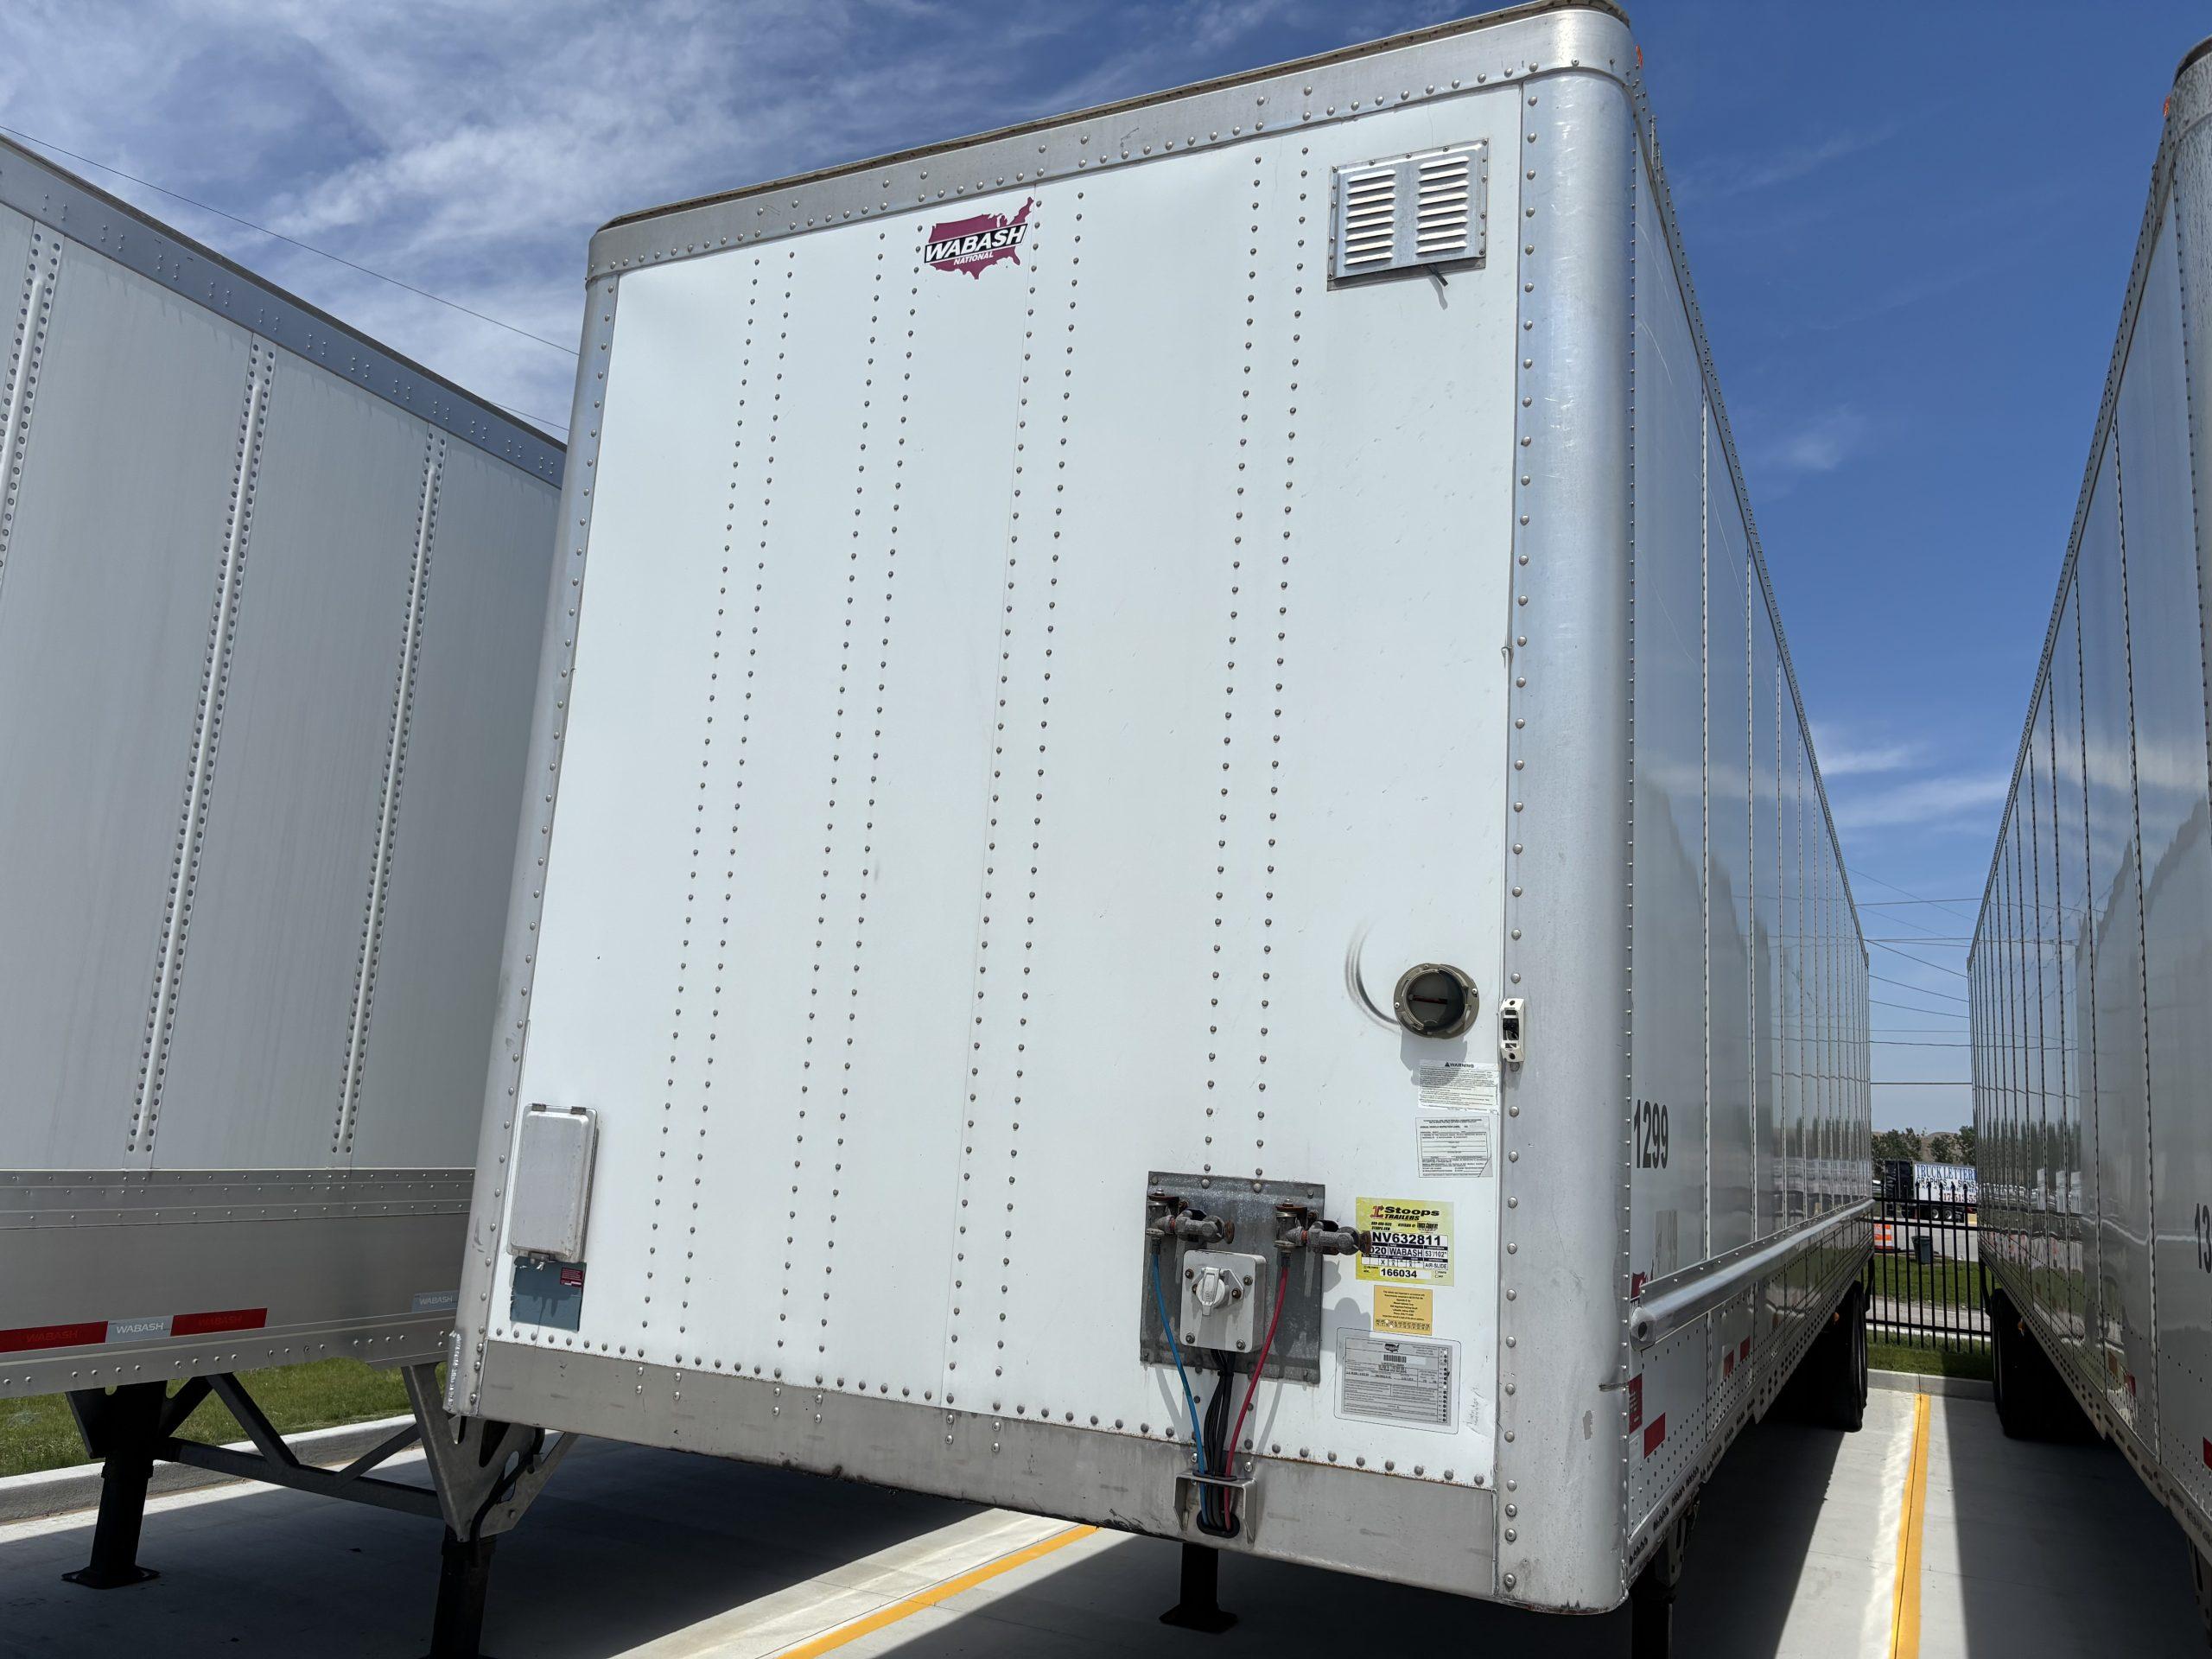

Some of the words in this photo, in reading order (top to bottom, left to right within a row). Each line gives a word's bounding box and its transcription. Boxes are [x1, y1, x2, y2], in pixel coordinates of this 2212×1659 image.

[925, 226, 1026, 262] WABASH
[953, 251, 994, 266] NATIONAL
[1633, 1099, 1669, 1169] 1299
[1916, 1164, 1942, 1179] TRUCK
[1384, 1206, 1440, 1217] Stoops
[1372, 1231, 1440, 1246] NV632811
[1389, 1248, 1422, 1257] WABASH
[1381, 1268, 1417, 1278] 166034
[419, 1295, 453, 1306] WABASH
[116, 1322, 164, 1334] WABASH
[27, 1329, 79, 1343] WABASH
